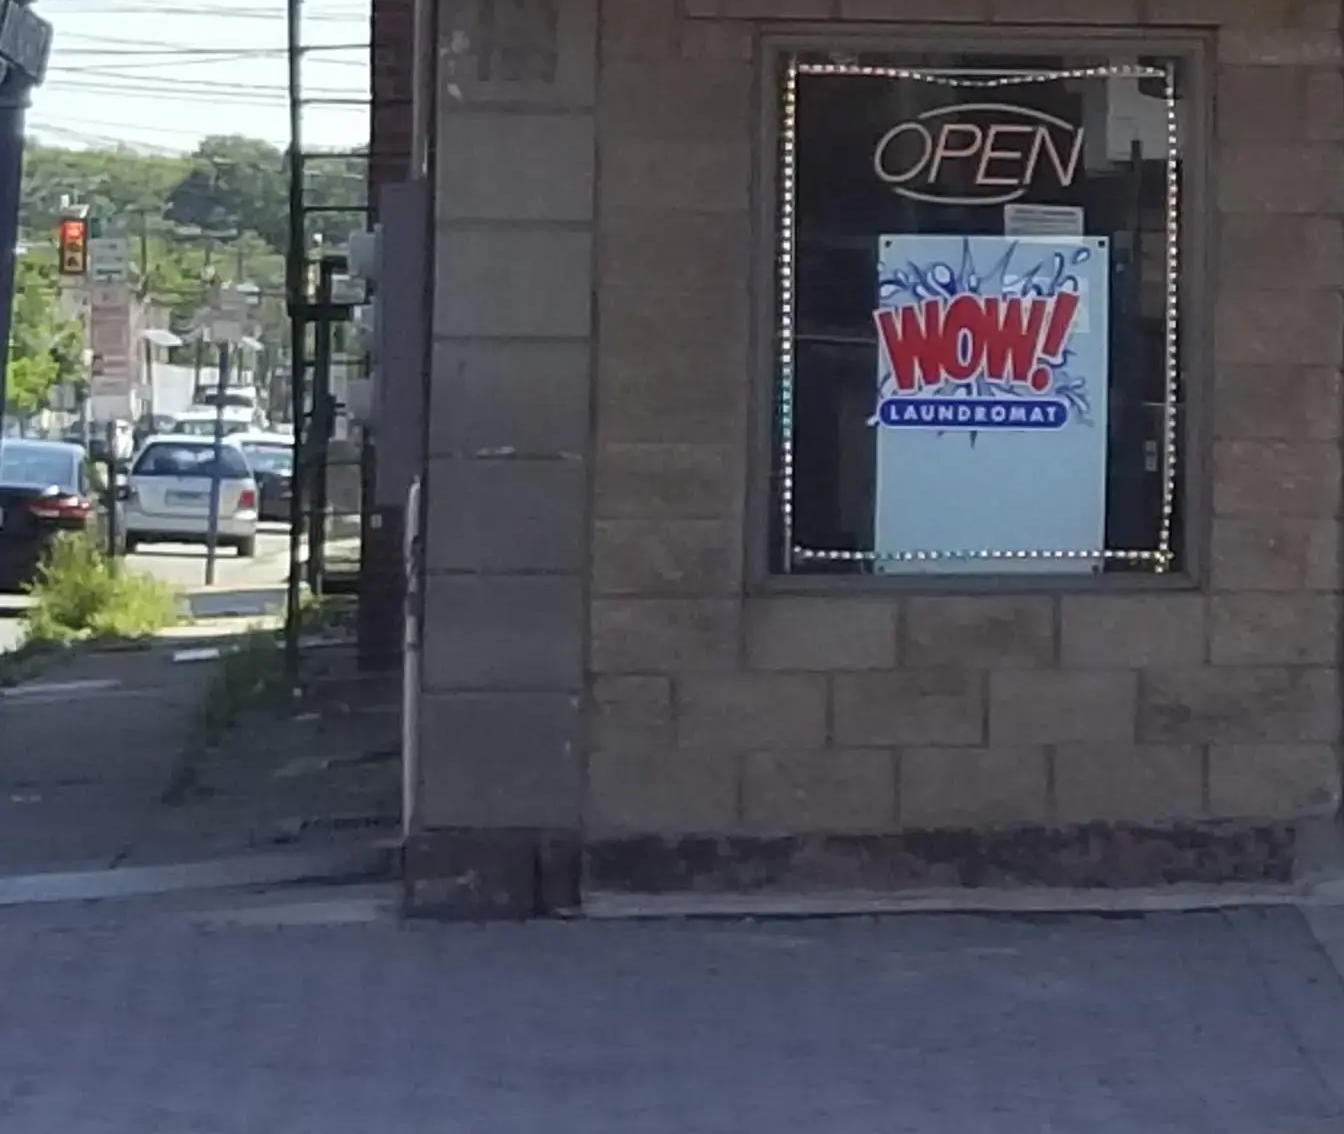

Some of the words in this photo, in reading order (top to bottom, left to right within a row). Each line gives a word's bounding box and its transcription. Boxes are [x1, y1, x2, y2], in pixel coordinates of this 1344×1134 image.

[873, 121, 1085, 187] OPEN
[873, 291, 1080, 396] WOW!
[889, 404, 1058, 424] LAUNDROMAT
